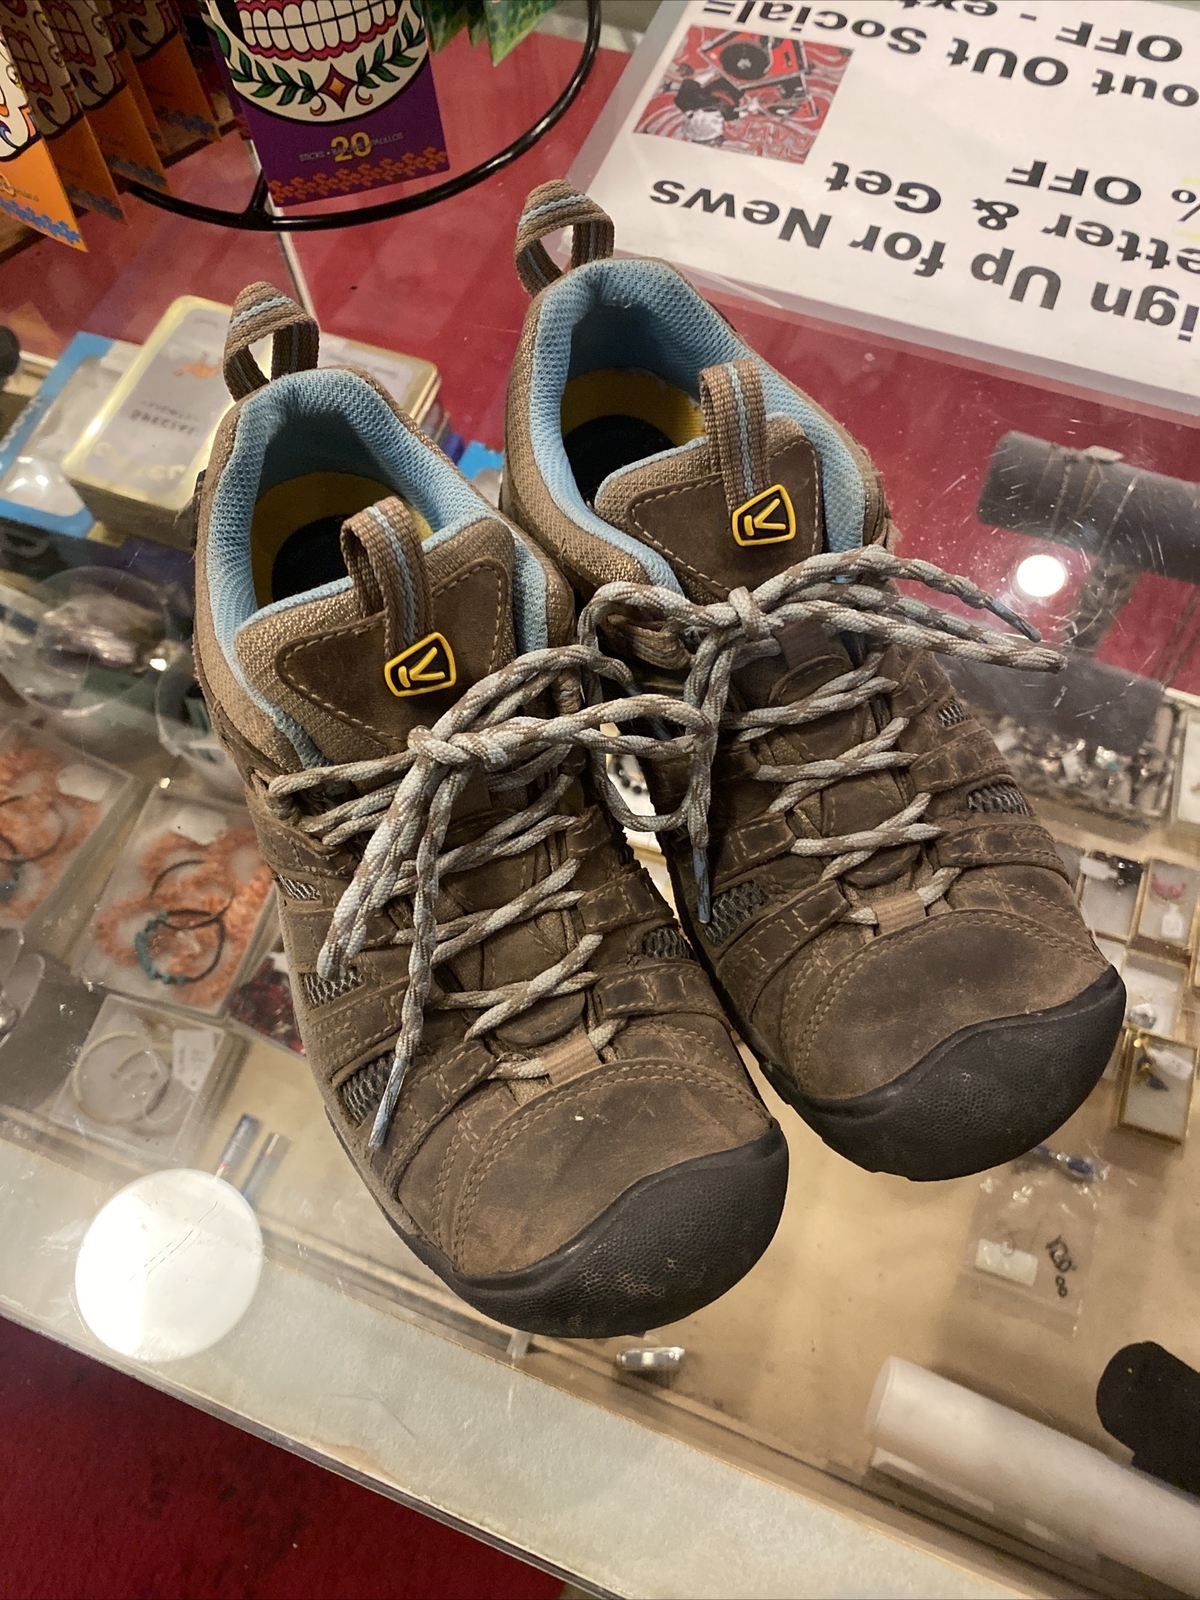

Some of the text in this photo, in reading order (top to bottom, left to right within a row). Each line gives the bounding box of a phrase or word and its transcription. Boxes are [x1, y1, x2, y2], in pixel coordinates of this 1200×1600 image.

[1055, 20, 1183, 62] OFF
[331, 131, 371, 162] 20
[825, 161, 942, 214] Get
[1004, 159, 1142, 206] OFF
[649, 179, 832, 249] News
[971, 197, 1020, 231] &
[848, 224, 947, 278] for
[970, 247, 1062, 311] Up
